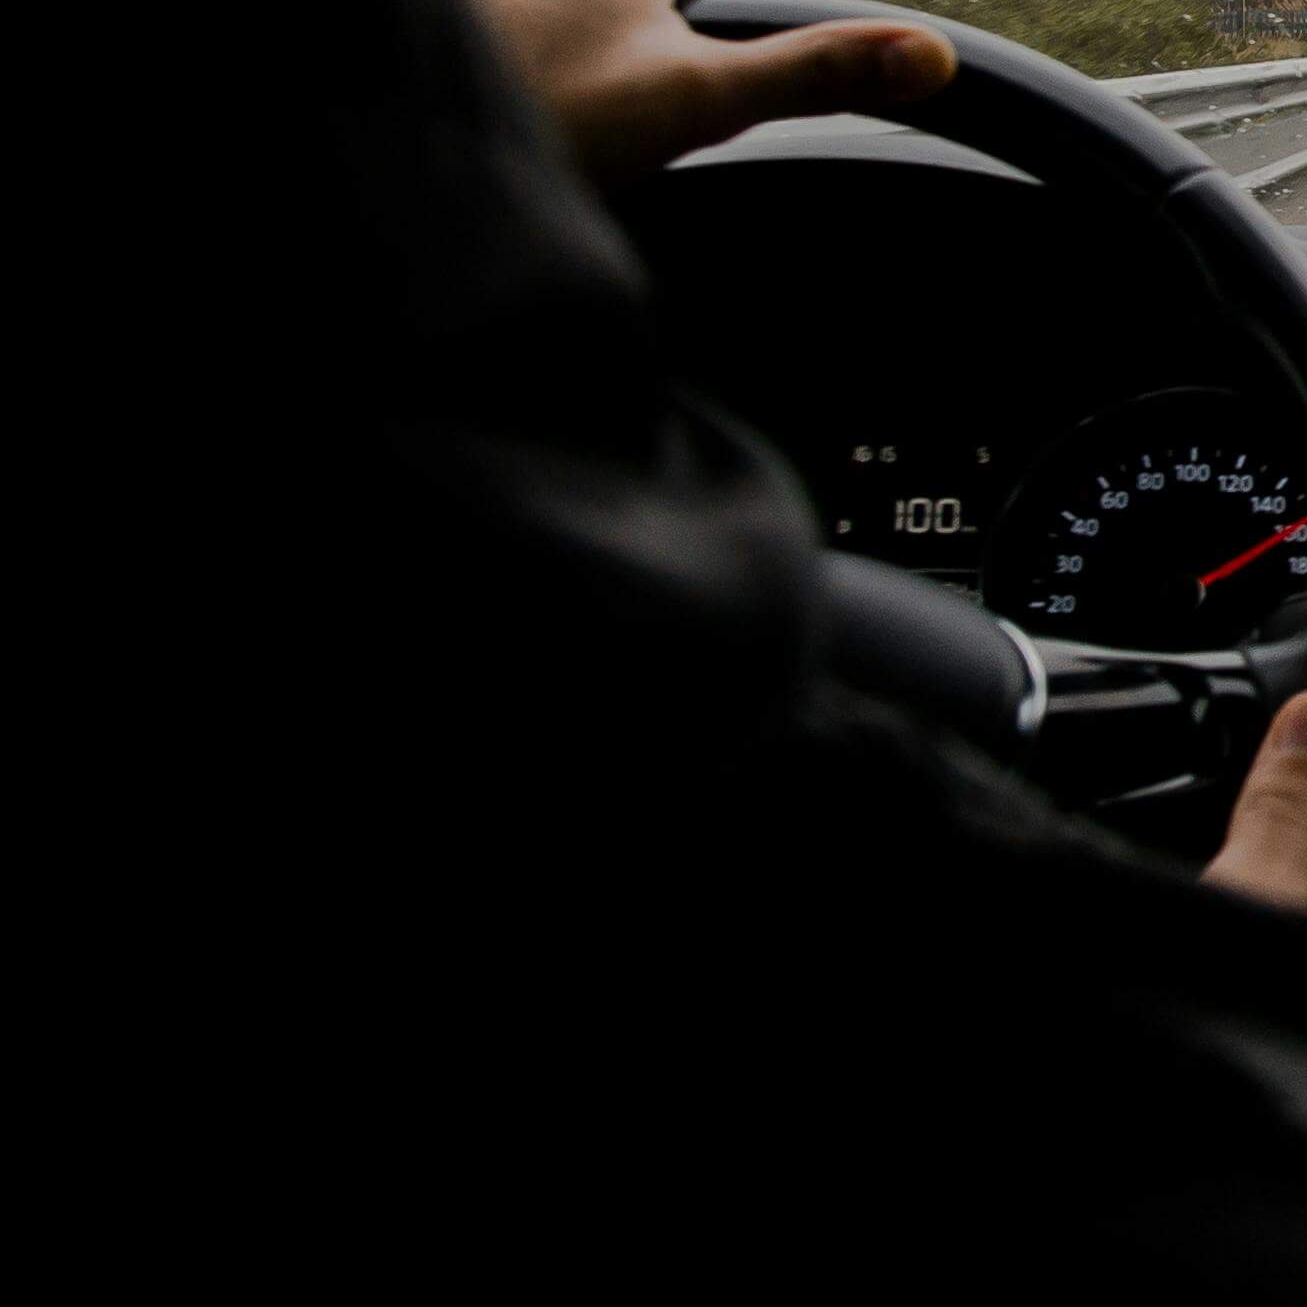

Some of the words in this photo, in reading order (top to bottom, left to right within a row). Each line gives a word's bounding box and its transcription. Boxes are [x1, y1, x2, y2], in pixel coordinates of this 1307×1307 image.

[1136, 472, 1165, 491] 80
[1174, 463, 1211, 482] 100
[1217, 474, 1254, 493] 120
[1099, 490, 1129, 510] 60
[1250, 495, 1286, 514] 140
[895, 496, 961, 534] 100
[1070, 518, 1100, 537] 40
[1055, 554, 1083, 574] 30
[1047, 594, 1076, 613] 20
